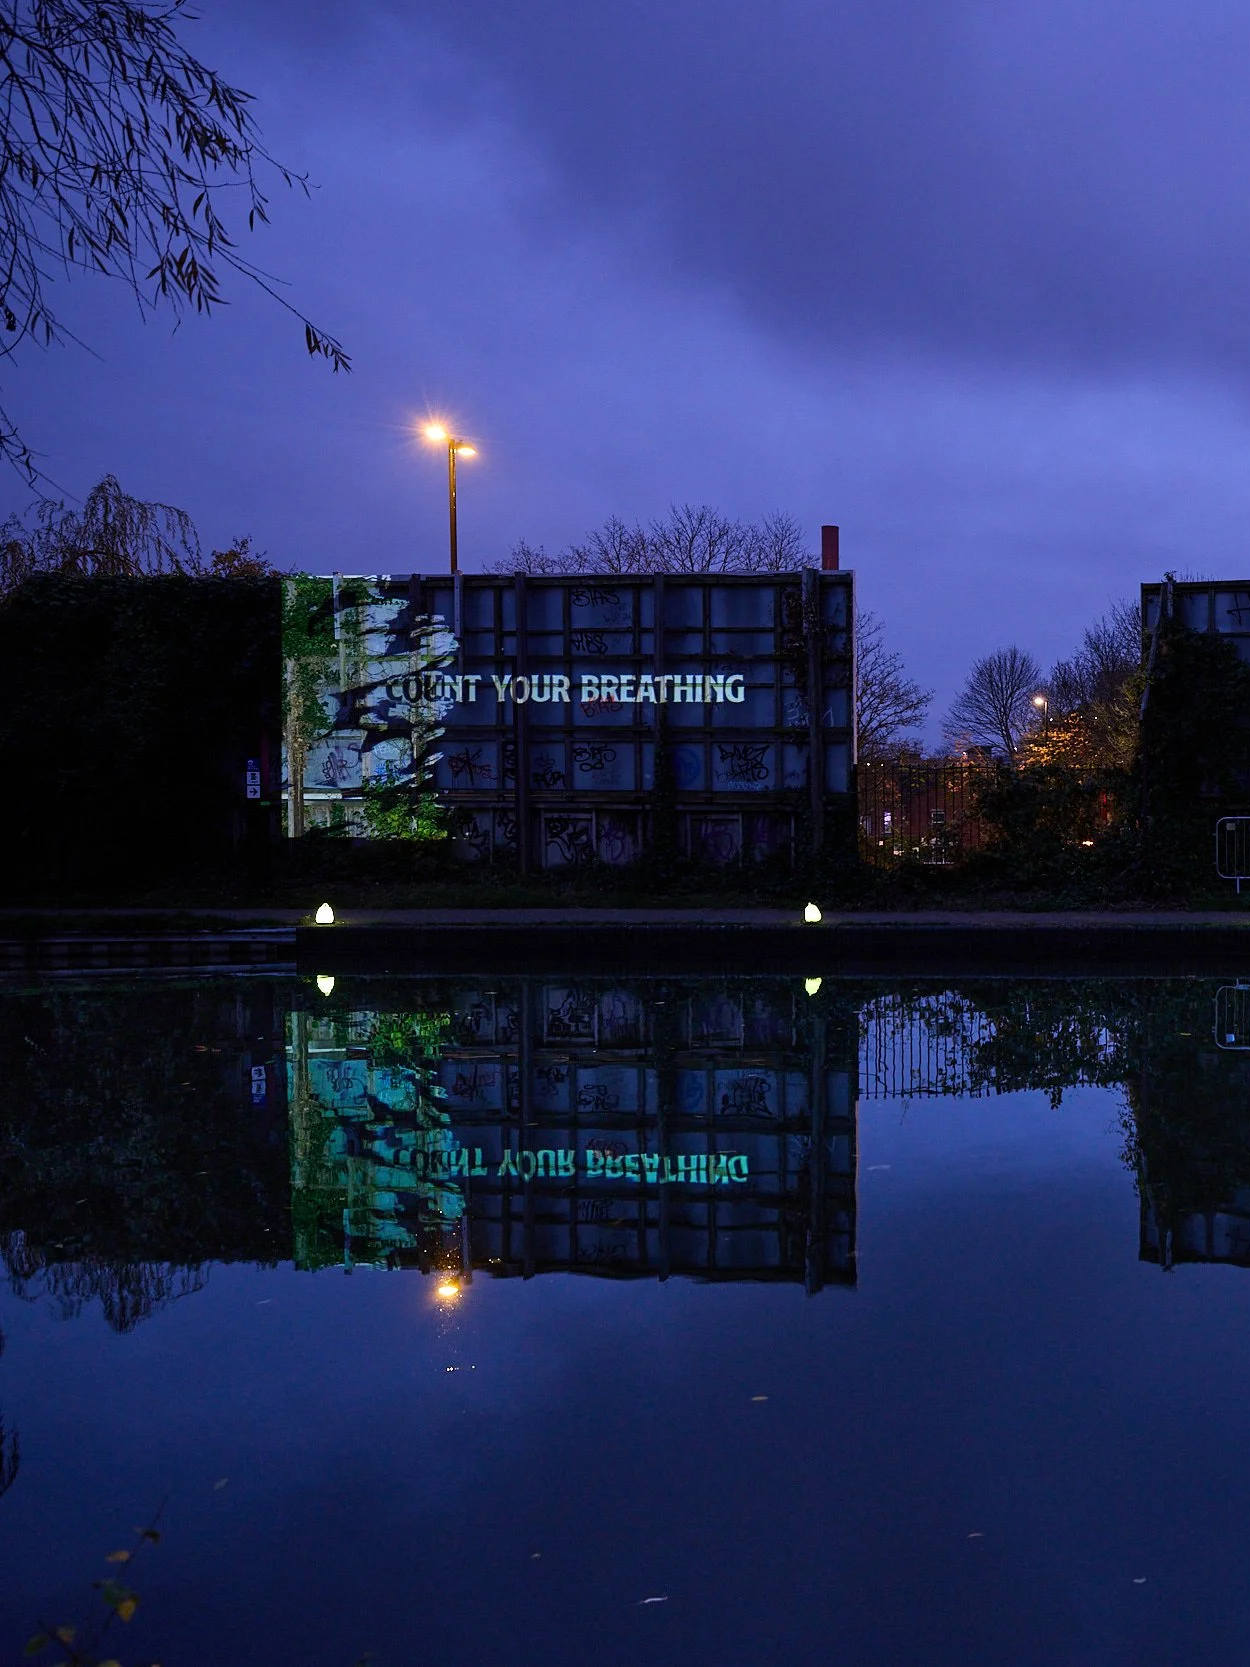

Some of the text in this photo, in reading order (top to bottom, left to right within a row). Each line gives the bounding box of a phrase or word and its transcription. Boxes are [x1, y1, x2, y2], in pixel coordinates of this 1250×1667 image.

[385, 672, 745, 704] COUNT YOUR BREATHING
